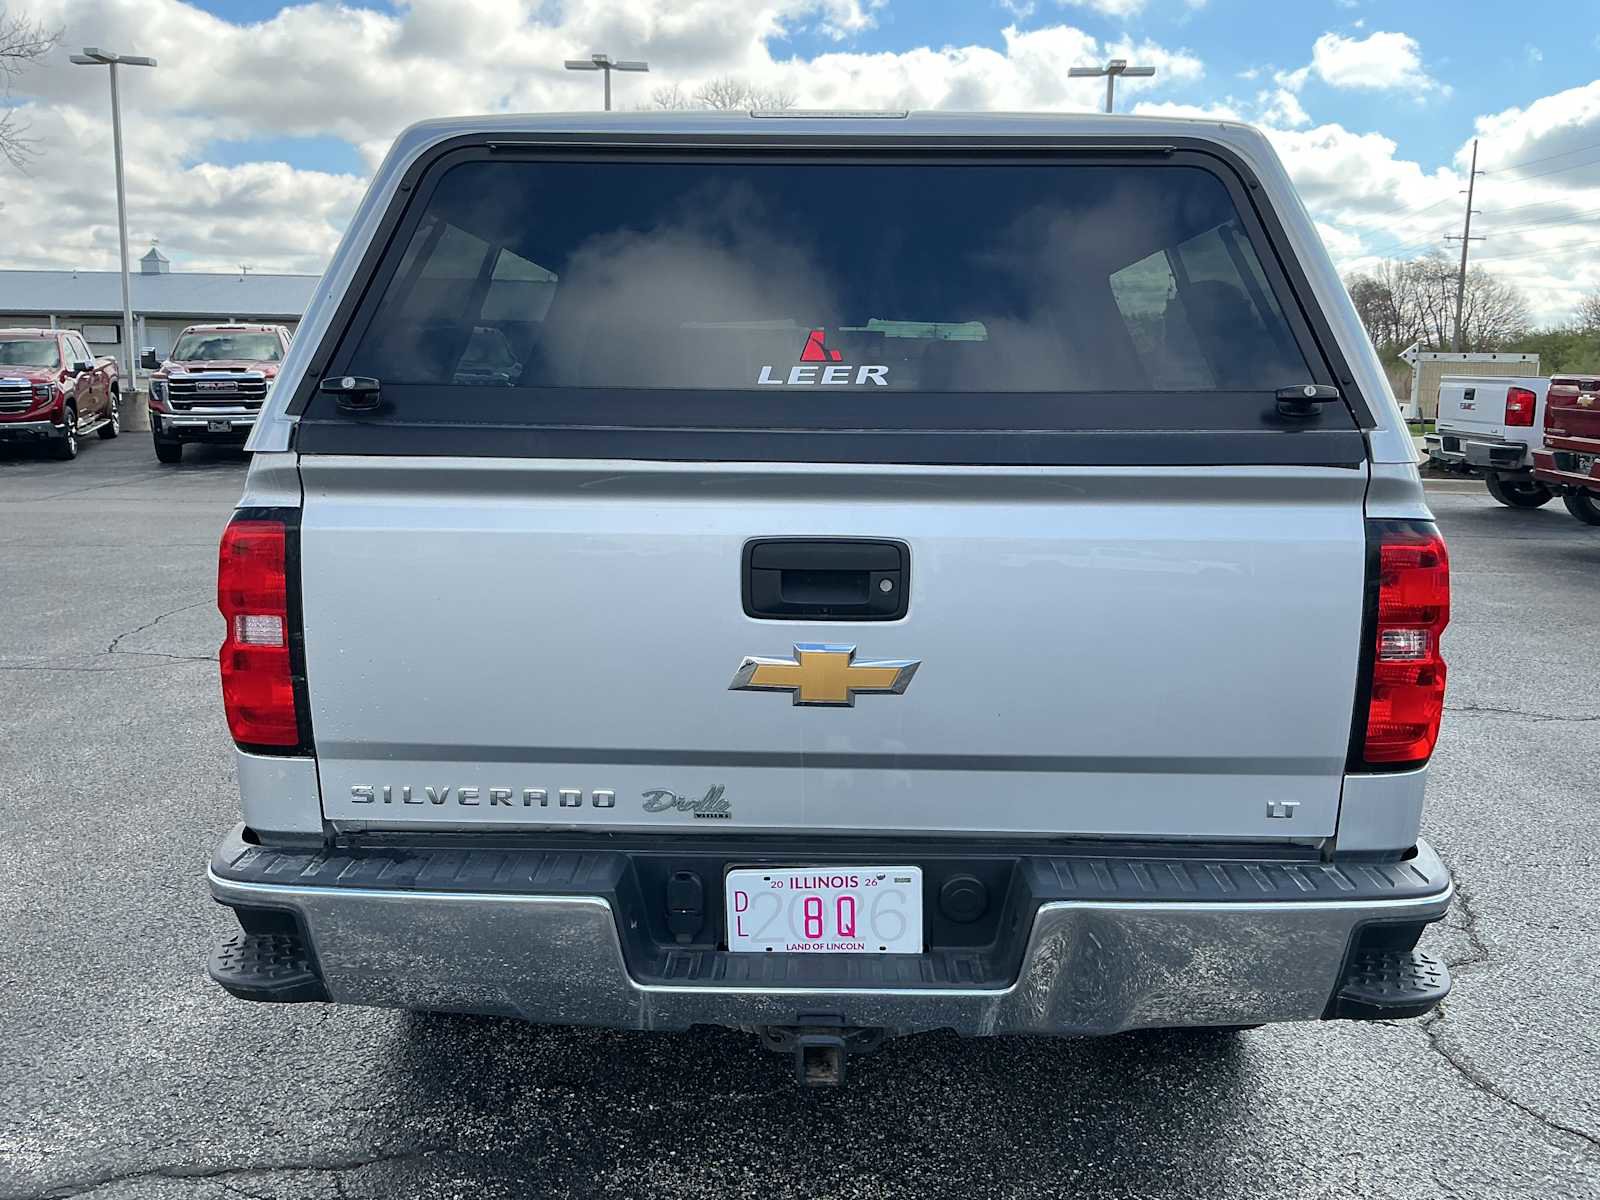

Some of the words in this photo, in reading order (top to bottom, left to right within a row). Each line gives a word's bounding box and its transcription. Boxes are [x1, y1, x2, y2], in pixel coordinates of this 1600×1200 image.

[757, 365, 889, 386] LEER
[351, 785, 616, 808] SILVERADO
[1266, 801, 1300, 818] LT
[770, 880, 784, 889] 20
[790, 875, 859, 889] ILLINOIS
[864, 878, 878, 887] 26
[786, 943, 811, 951] LAND
[812, 943, 824, 951] OF
[826, 942, 865, 950] LINCOLN
